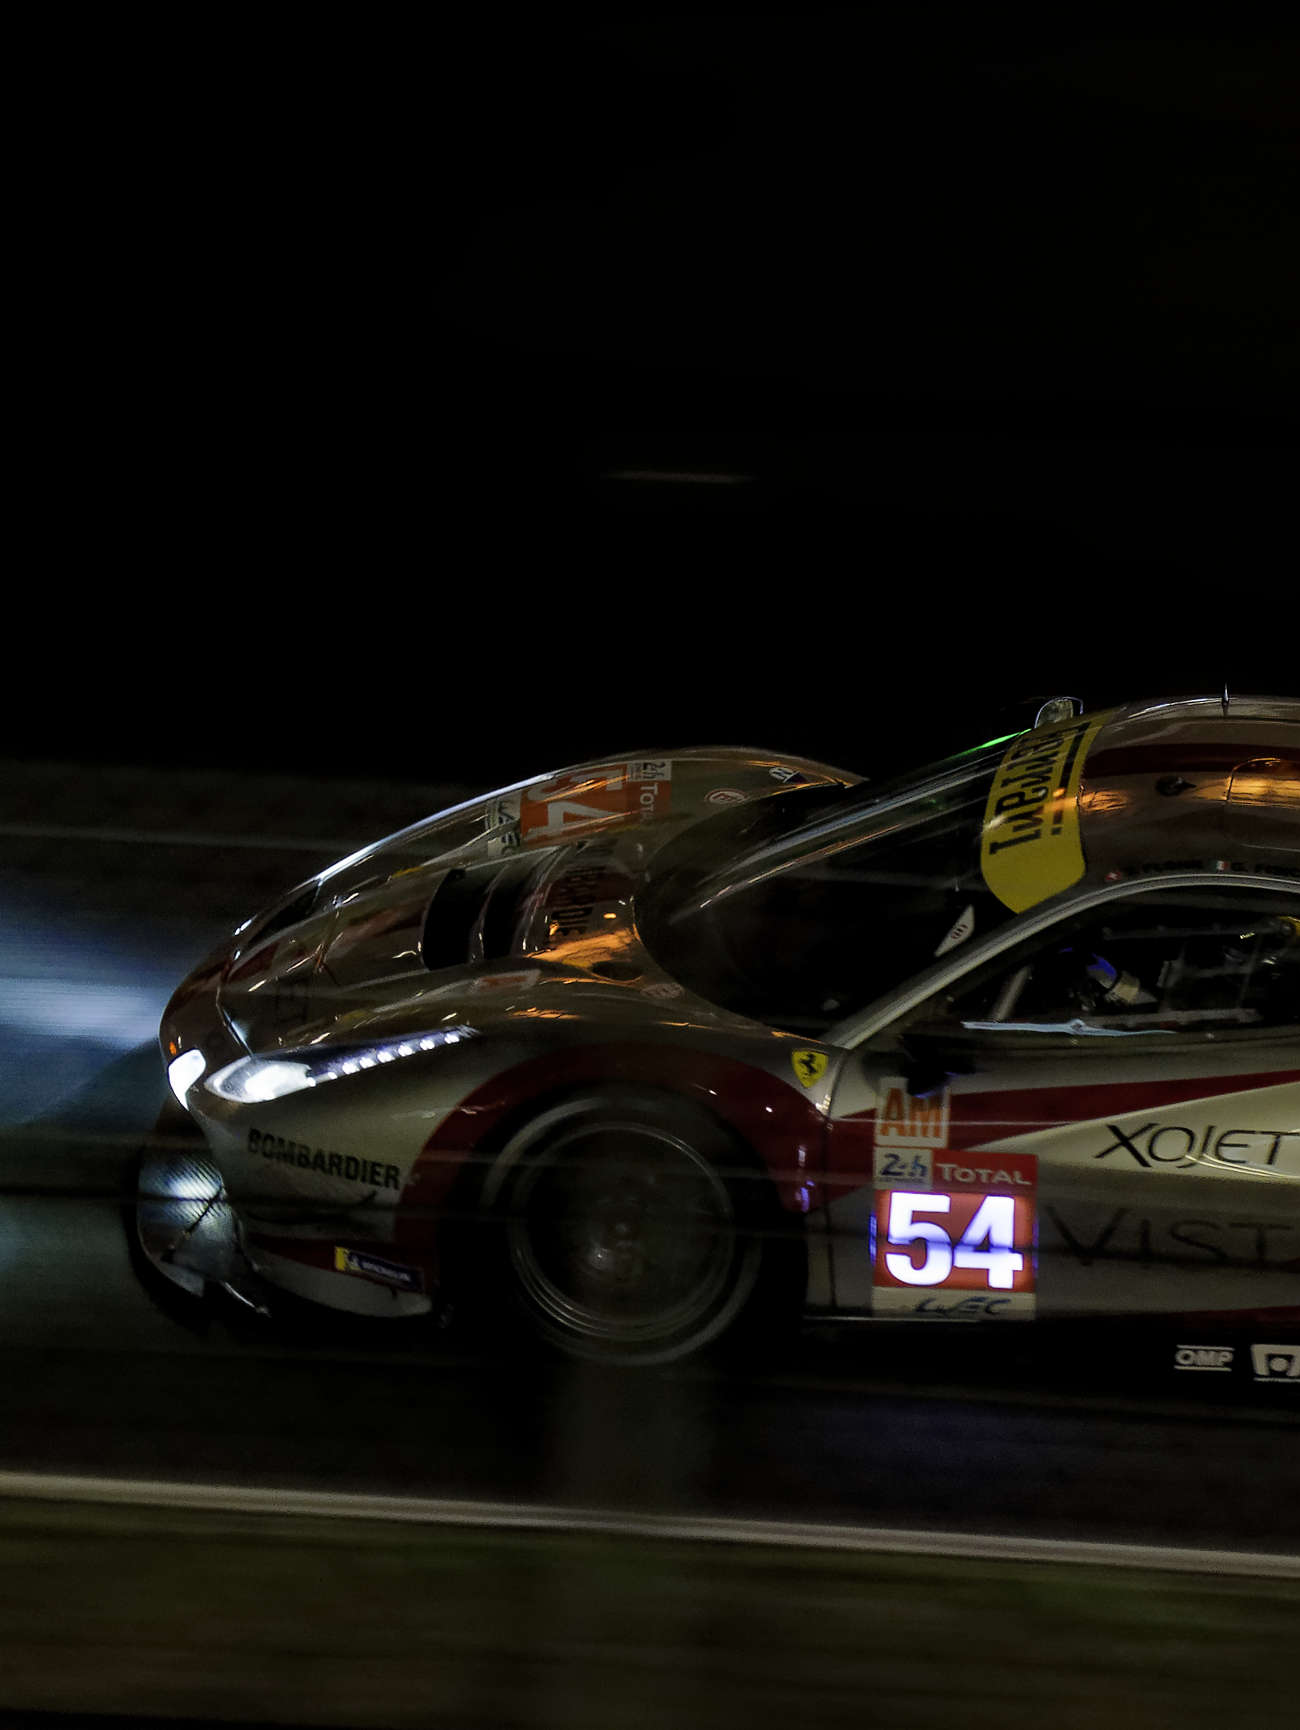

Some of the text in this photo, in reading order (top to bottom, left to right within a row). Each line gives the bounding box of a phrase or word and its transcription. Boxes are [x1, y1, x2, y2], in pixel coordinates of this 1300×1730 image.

[879, 1087, 944, 1138] AM
[248, 1127, 401, 1190] BOMBARDIER
[935, 1162, 1033, 1186] TOTAL
[884, 1191, 1025, 1290] 54
[1174, 1349, 1235, 1367] OMP
